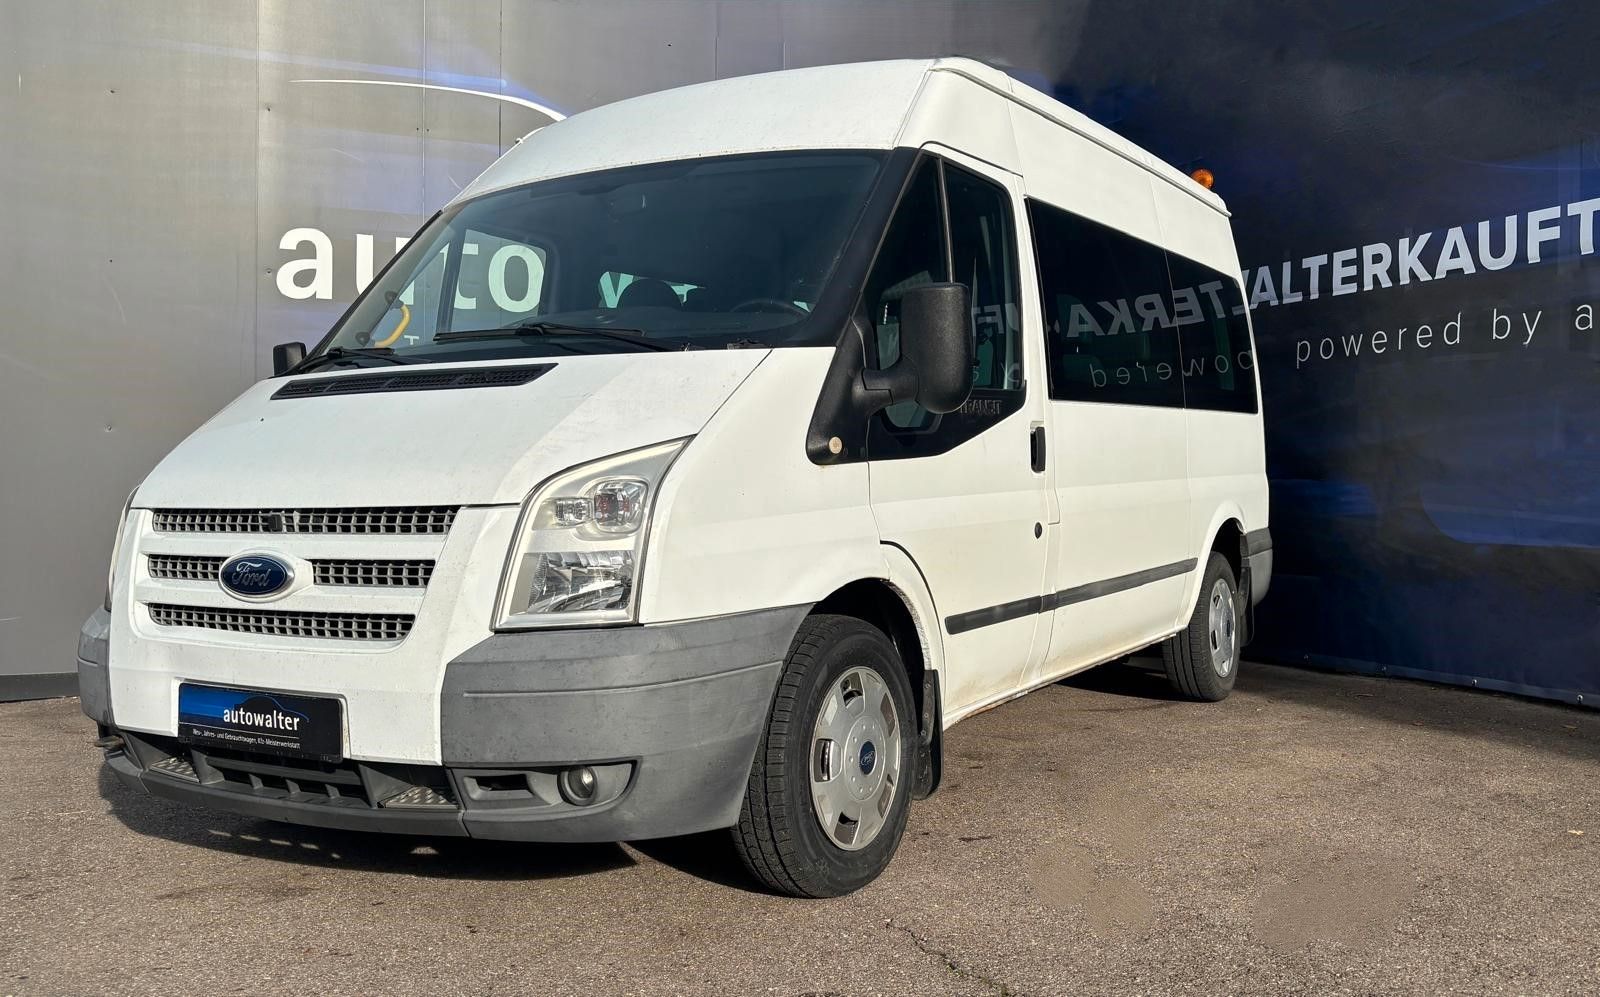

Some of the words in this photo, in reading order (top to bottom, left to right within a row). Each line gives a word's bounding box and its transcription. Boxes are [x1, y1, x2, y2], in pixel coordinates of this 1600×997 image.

[1241, 197, 1600, 309] ALTERKAUFT
[1296, 312, 1461, 369] powered
[1492, 308, 1542, 348] by
[232, 562, 271, 586] Ford
[223, 707, 299, 731] autowalter
